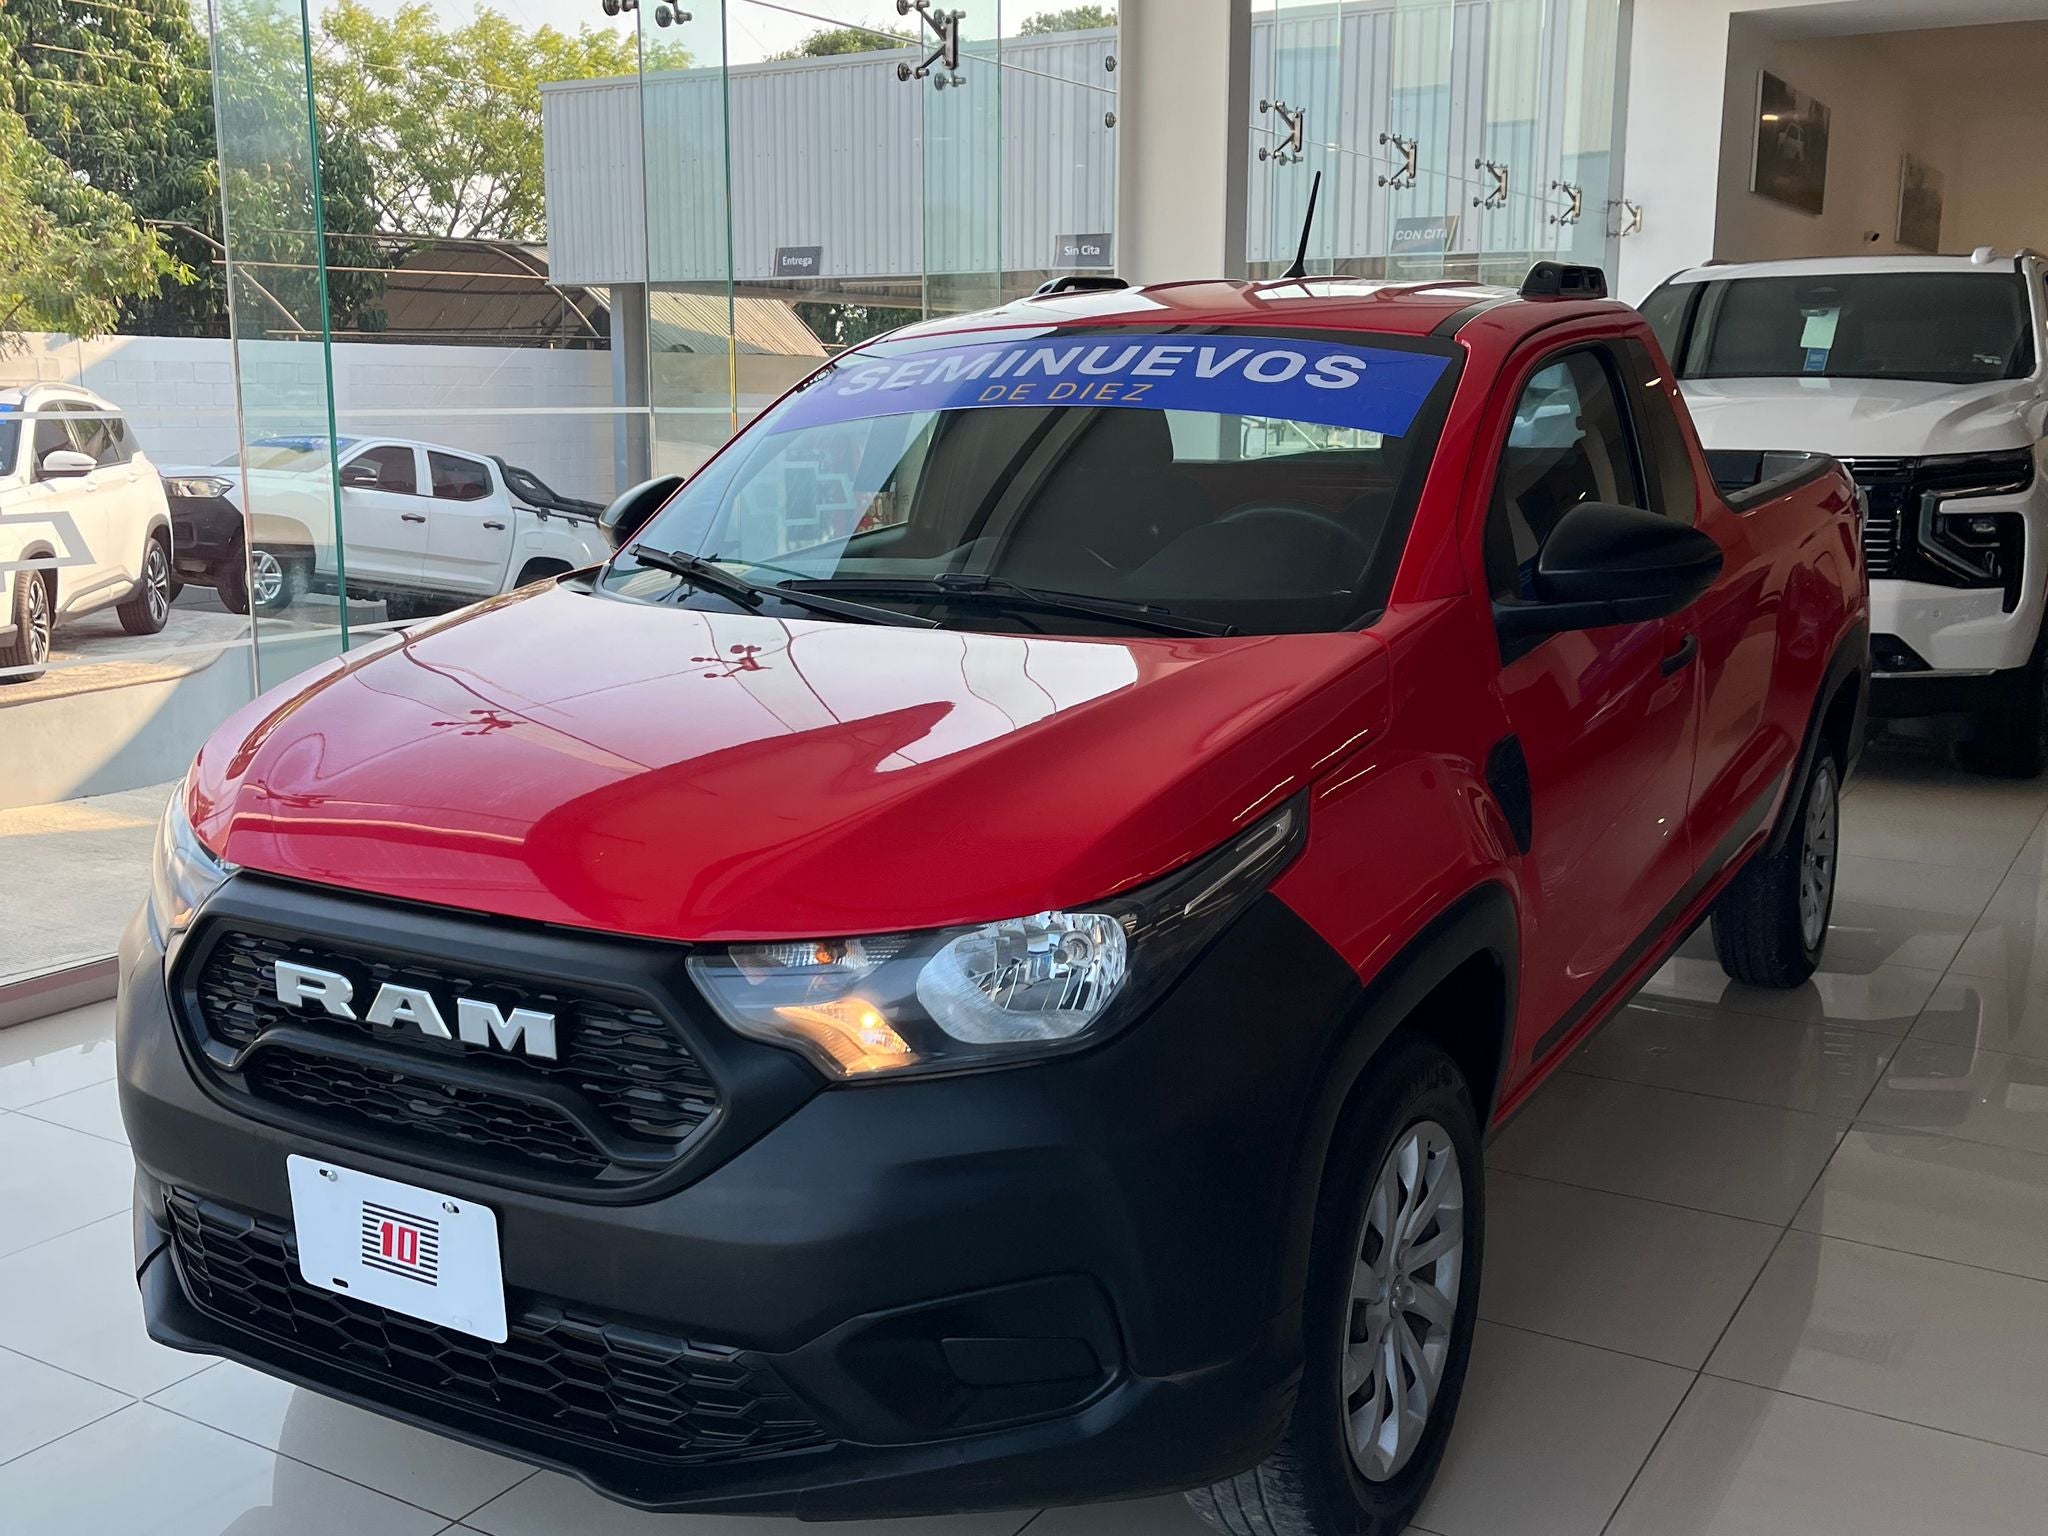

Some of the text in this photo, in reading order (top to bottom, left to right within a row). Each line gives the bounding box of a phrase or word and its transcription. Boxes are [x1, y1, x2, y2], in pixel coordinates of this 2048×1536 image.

[1395, 229, 1422, 241] CON
[1064, 244, 1101, 256] Sin Cita
[782, 256, 813, 267] Entrega
[838, 346, 1368, 397] SEMINUEVOS
[978, 382, 1154, 402] DE DIEZ
[274, 960, 558, 1060] RAM
[380, 1221, 418, 1266] 10
